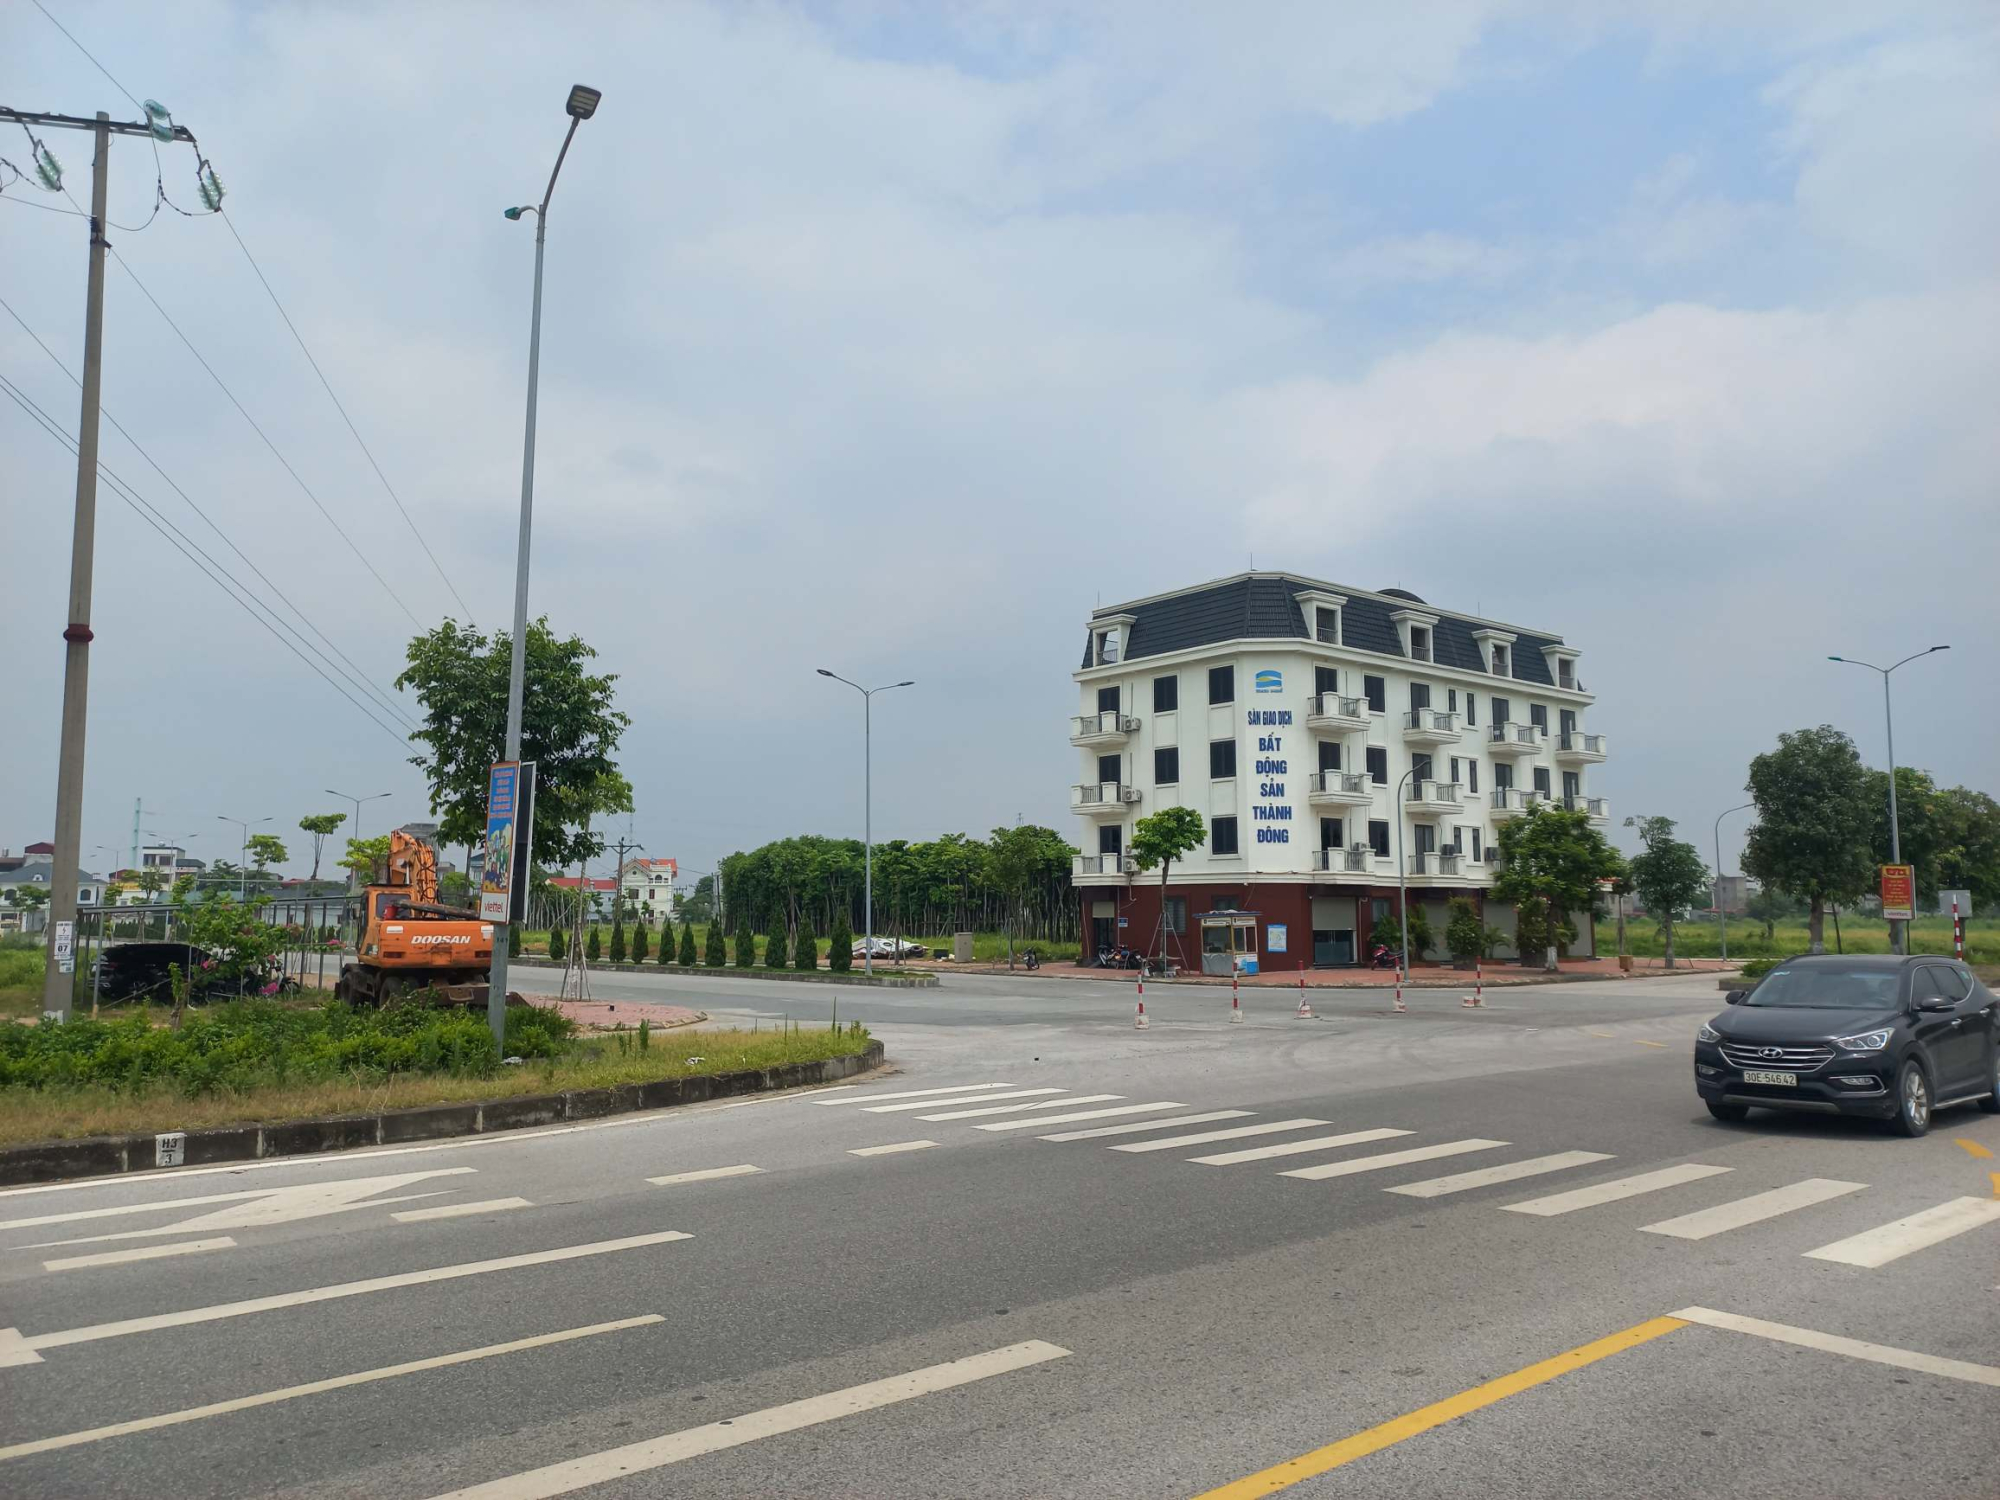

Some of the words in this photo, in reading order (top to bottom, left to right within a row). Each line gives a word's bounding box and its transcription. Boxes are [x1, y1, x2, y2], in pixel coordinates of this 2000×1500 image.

[1248, 708, 1261, 725] SÀN
[1263, 711, 1277, 725] GIAO
[1278, 711, 1293, 728] DỊCH
[1259, 732, 1281, 751] BẤT
[1256, 756, 1287, 777] ĐỘNG
[1260, 777, 1284, 797] SẢN
[1253, 803, 1292, 820] THÀNH
[1257, 826, 1289, 843] ĐÔNG
[411, 935, 471, 944] DOOSAN
[162, 1138, 177, 1148] H3
[165, 1153, 172, 1164] 3
